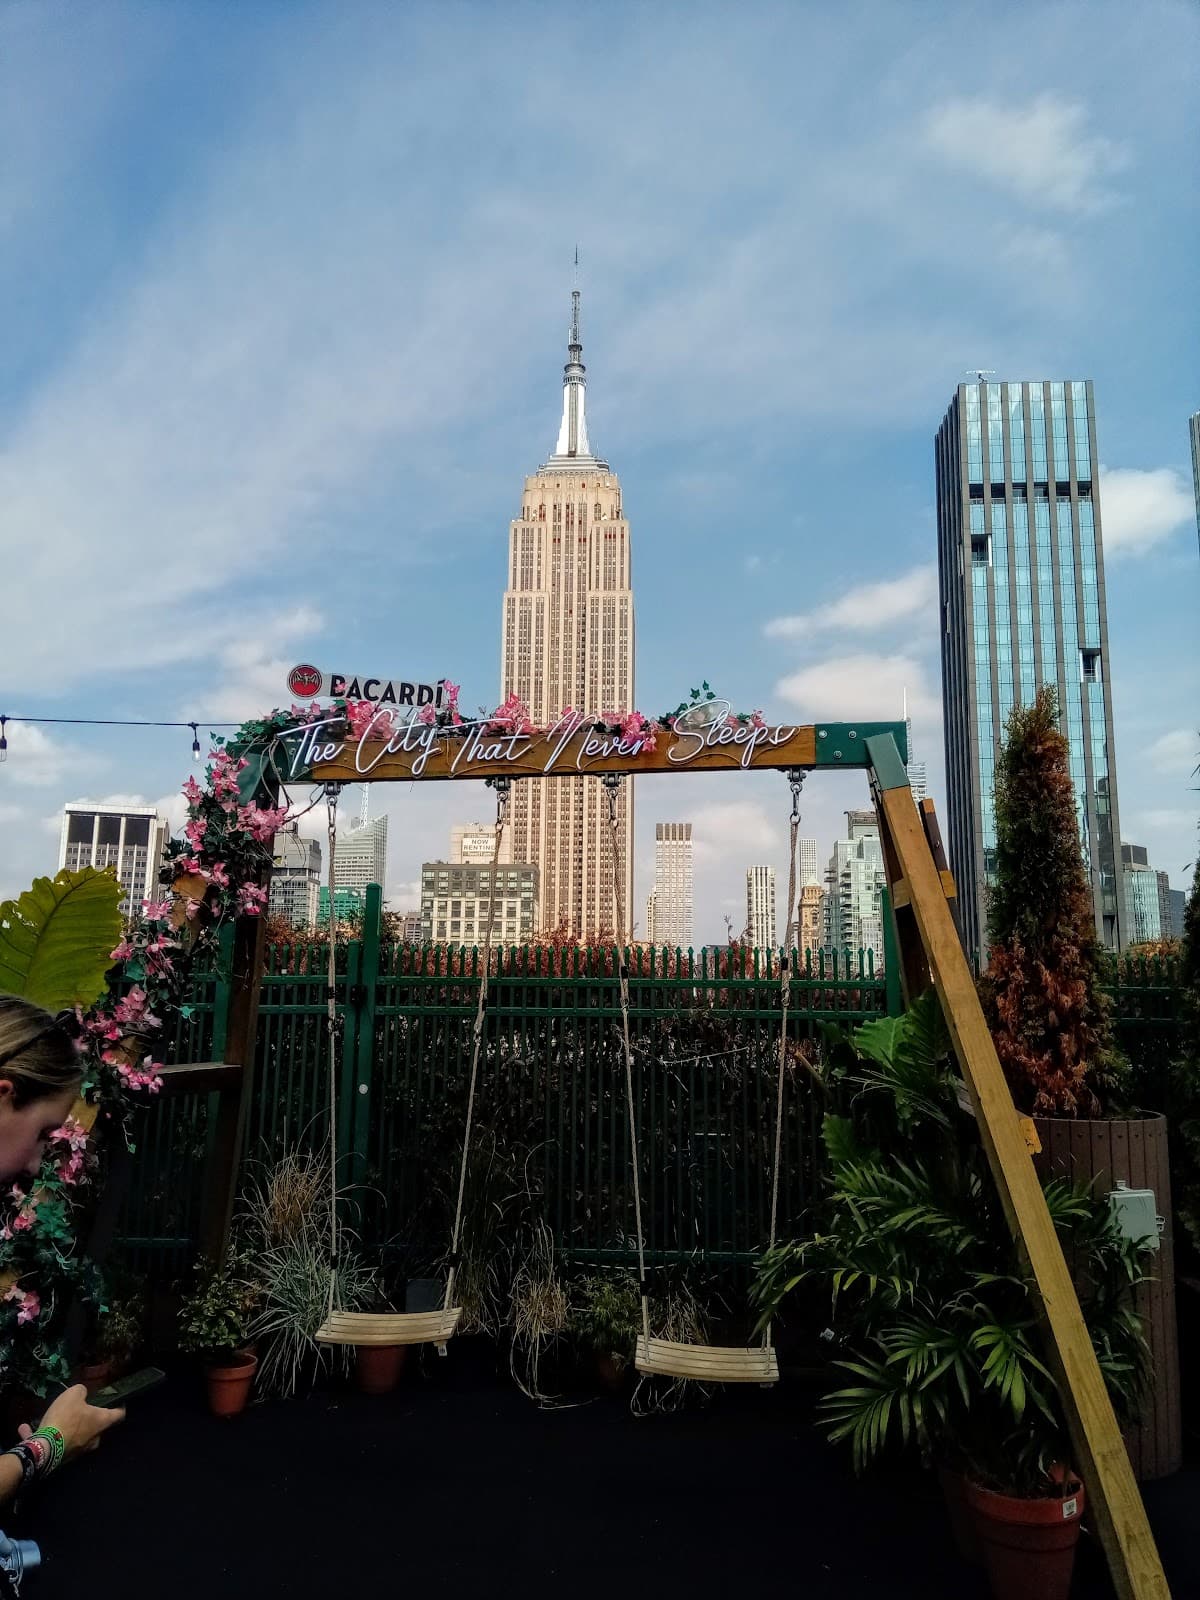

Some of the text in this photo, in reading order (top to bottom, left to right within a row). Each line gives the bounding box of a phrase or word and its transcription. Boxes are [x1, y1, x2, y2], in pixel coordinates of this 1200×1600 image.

[330, 674, 446, 709] BACARDÍ
[277, 699, 797, 777] The City That Never Sleeps
